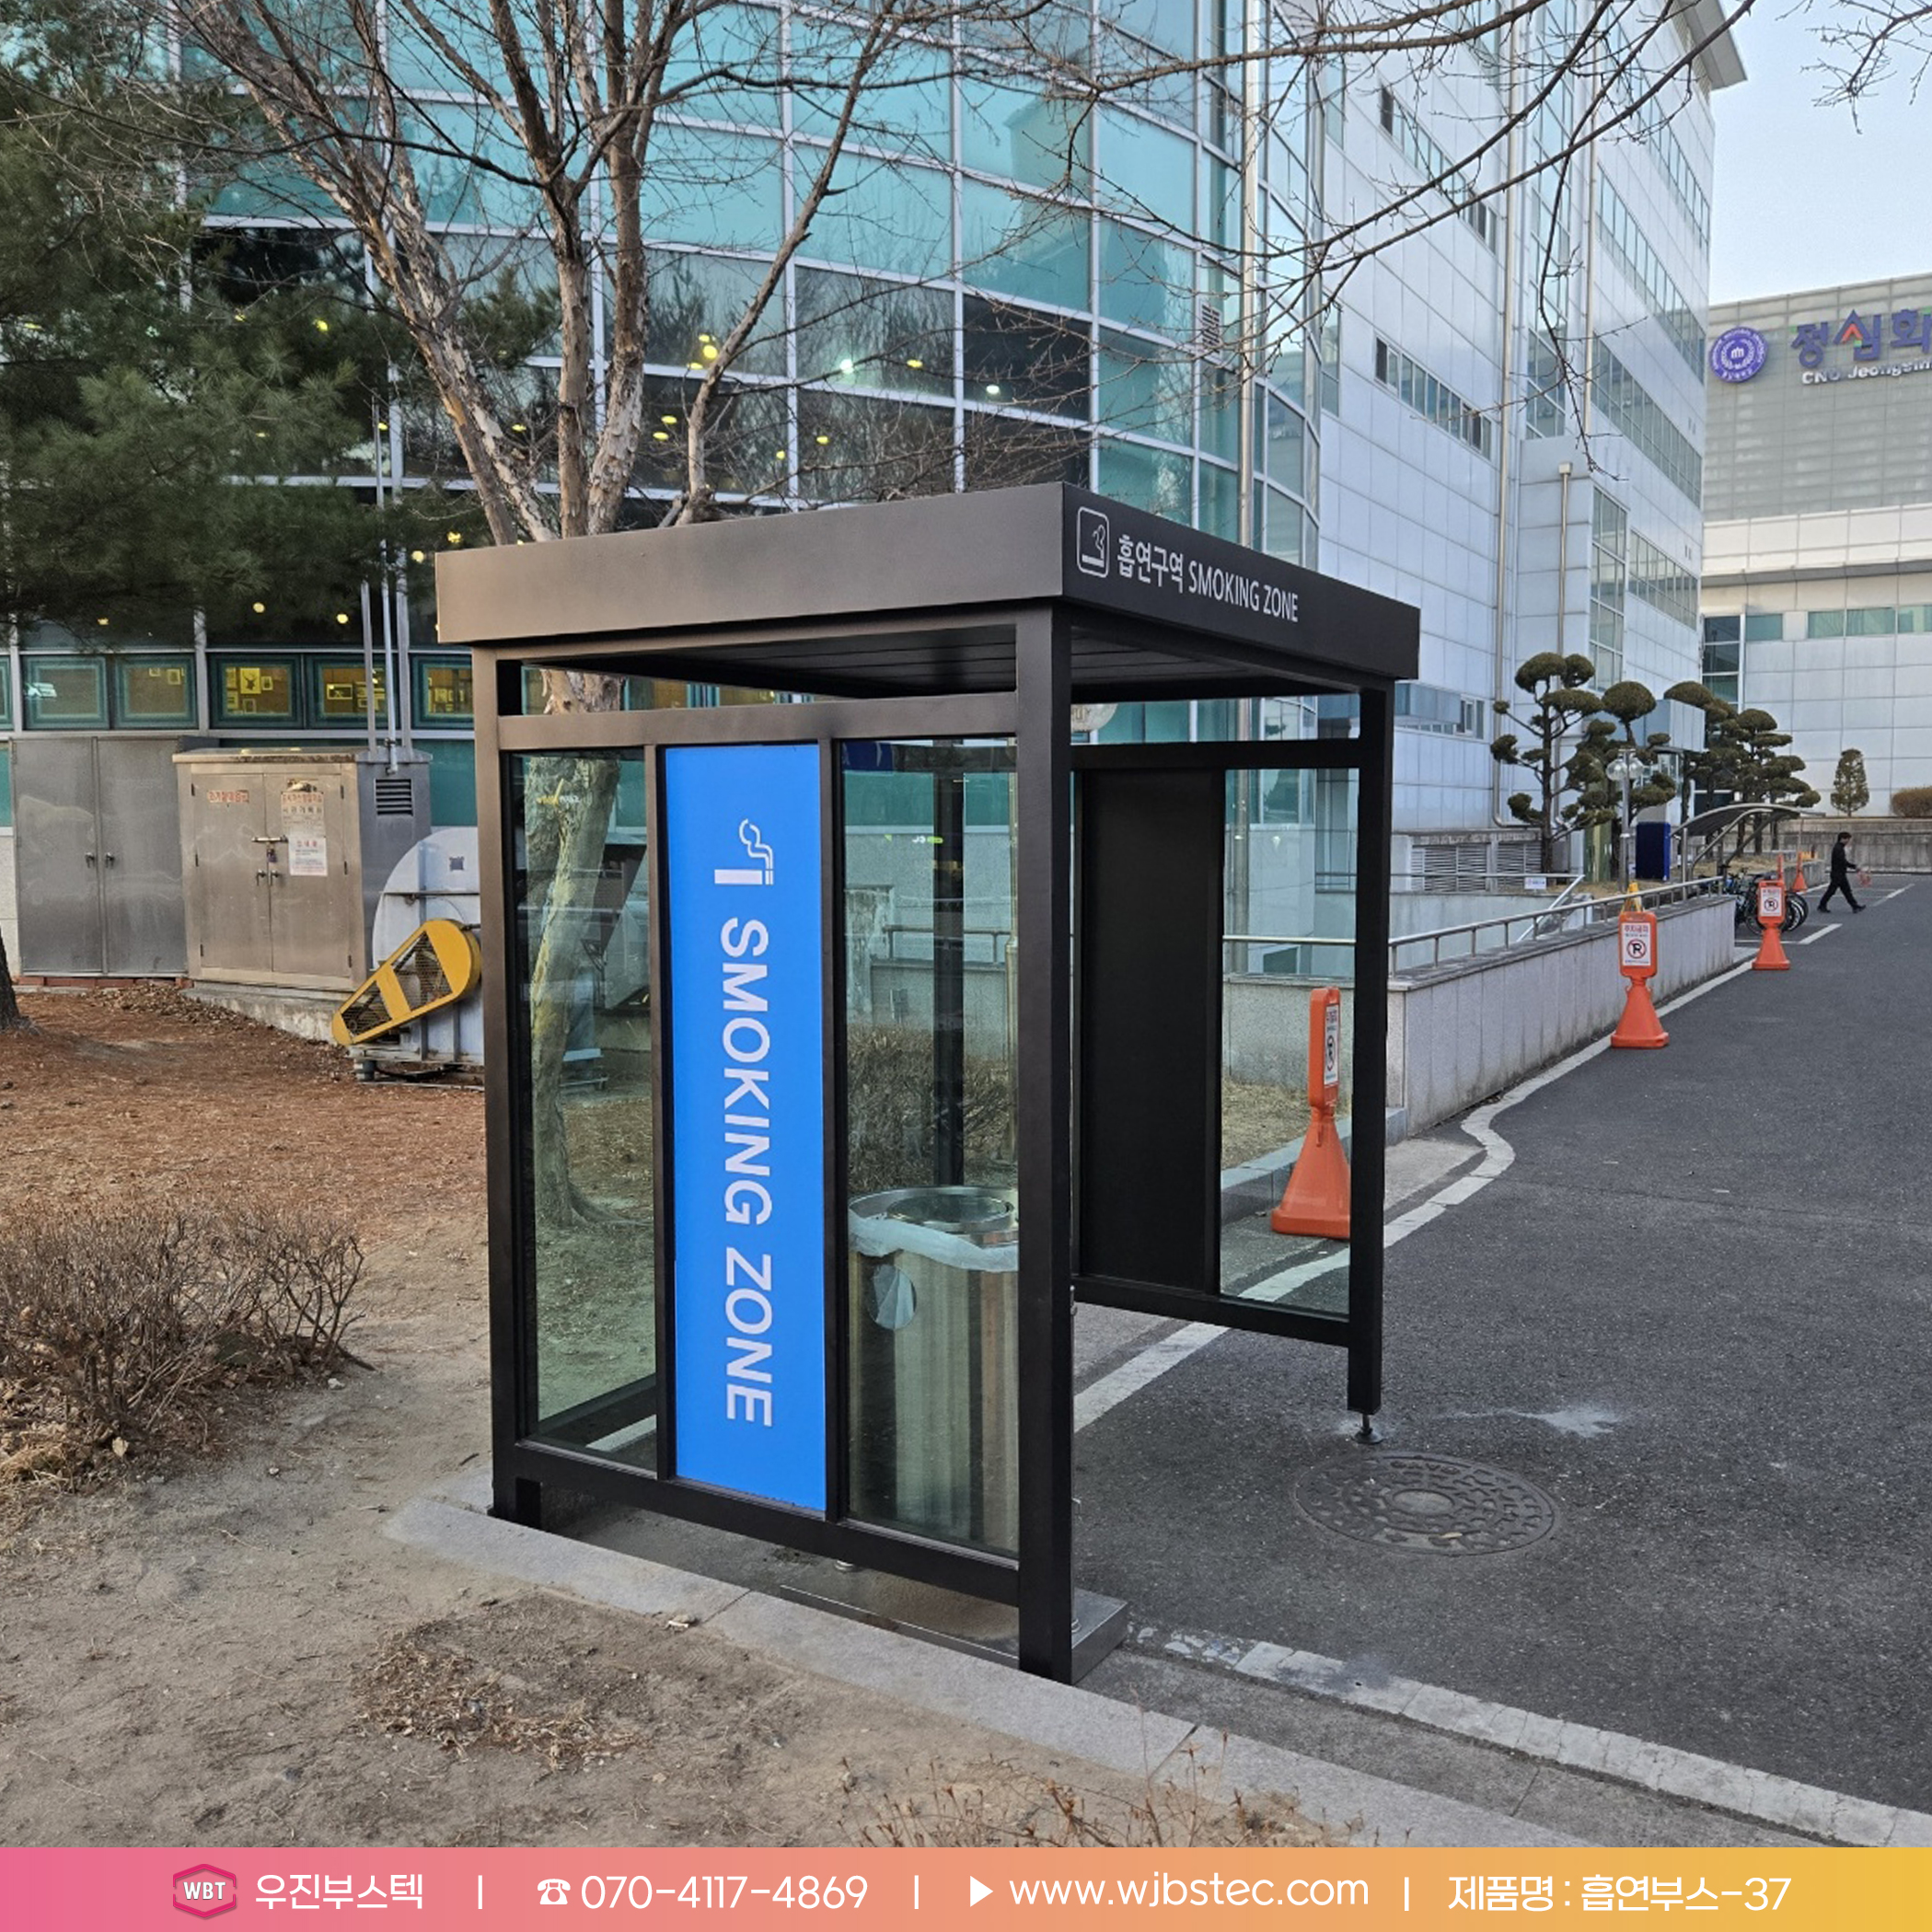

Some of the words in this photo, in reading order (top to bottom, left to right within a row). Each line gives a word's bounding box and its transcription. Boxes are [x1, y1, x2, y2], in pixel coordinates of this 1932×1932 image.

[1116, 534, 1184, 594] 흡연구역
[1188, 560, 1260, 613] SMOKING
[1262, 584, 1299, 623] ZONE
[721, 918, 772, 1224] SMOKING
[725, 1247, 773, 1426] ZONE
